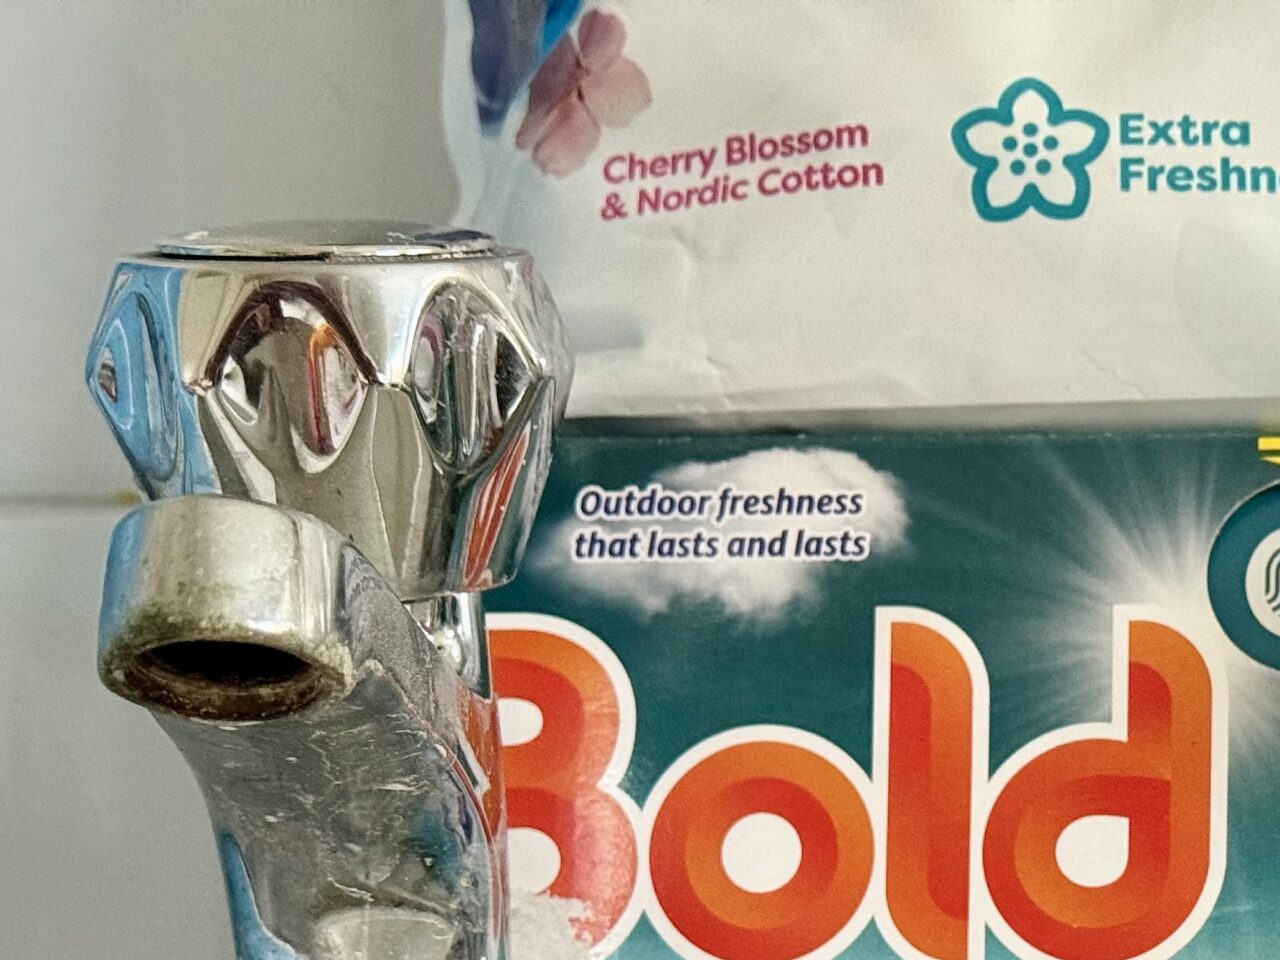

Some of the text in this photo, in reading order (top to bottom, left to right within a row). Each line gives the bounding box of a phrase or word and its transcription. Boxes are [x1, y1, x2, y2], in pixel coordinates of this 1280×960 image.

[1119, 113, 1250, 147] Extra
[603, 123, 869, 184] Cherry Blossom
[600, 162, 884, 221] & Nordic Cotton
[579, 486, 864, 522] Outdoor freshness
[575, 529, 868, 559] that lasts and lasts
